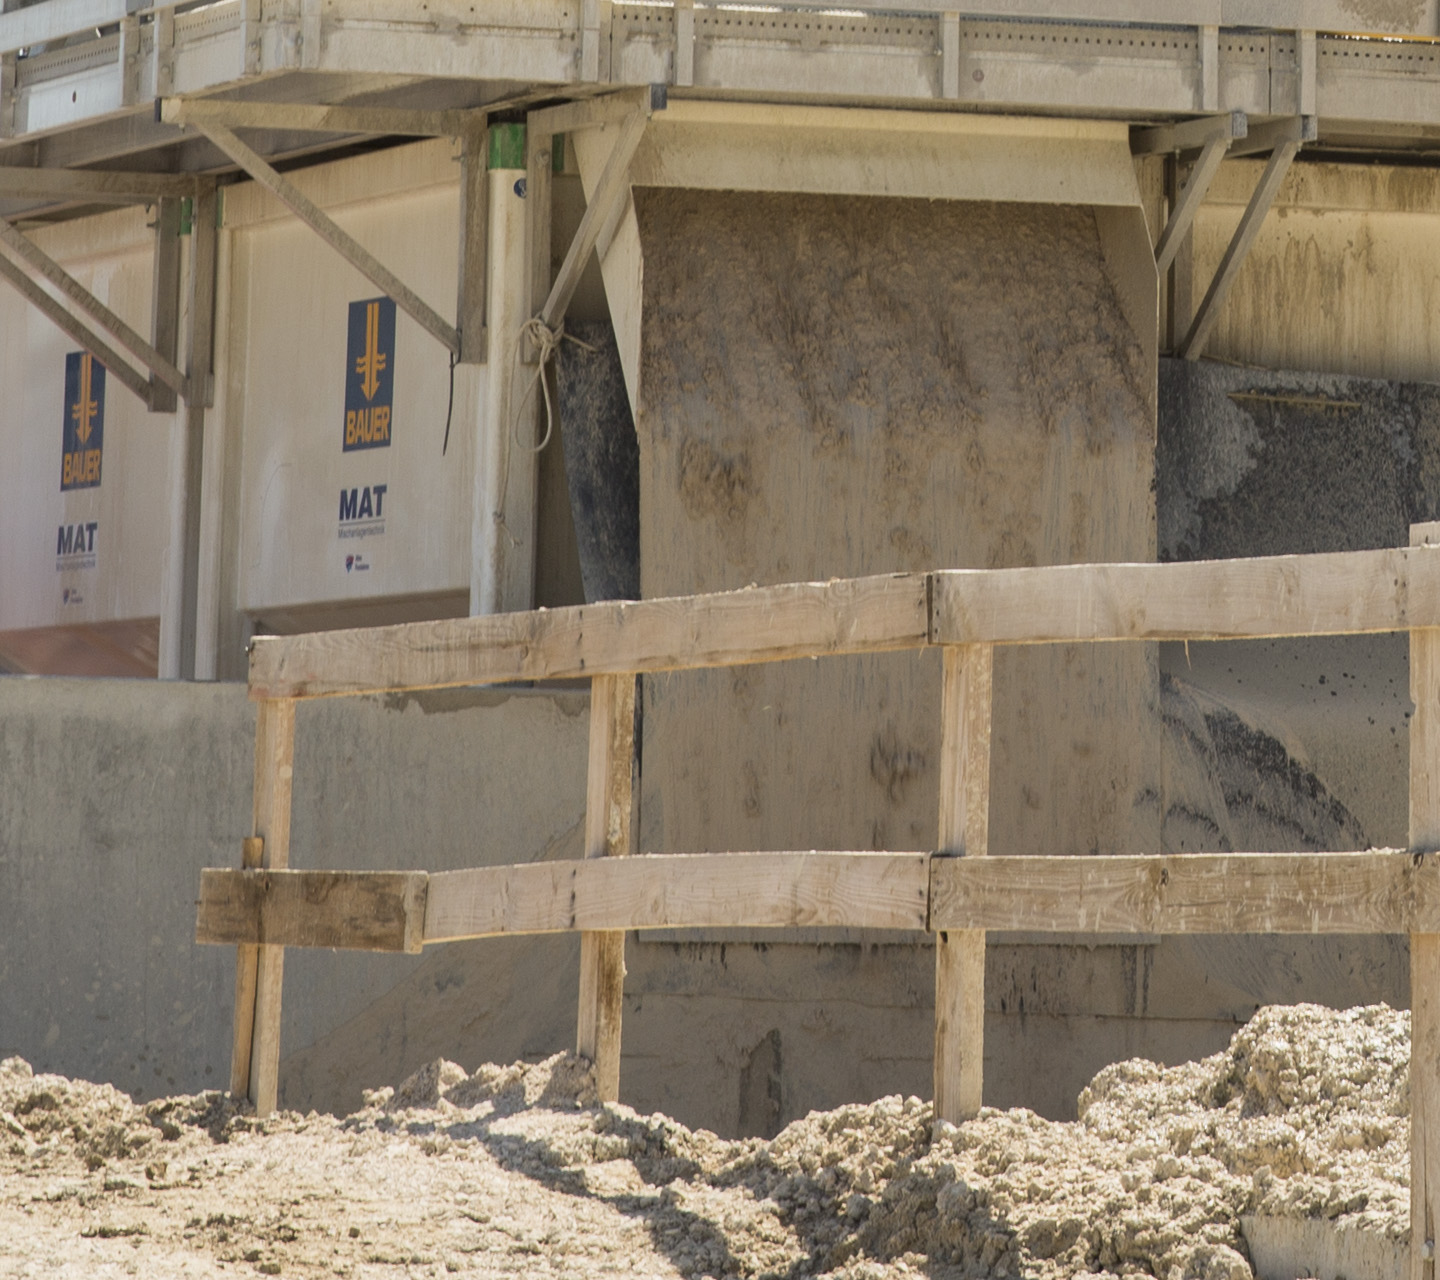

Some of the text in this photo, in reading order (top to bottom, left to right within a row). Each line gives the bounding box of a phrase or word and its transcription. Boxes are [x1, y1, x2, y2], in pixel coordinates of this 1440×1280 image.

[347, 405, 390, 445] BAUER
[63, 448, 101, 485] BAUER
[339, 484, 387, 522] MAT
[57, 521, 98, 555] MAT
